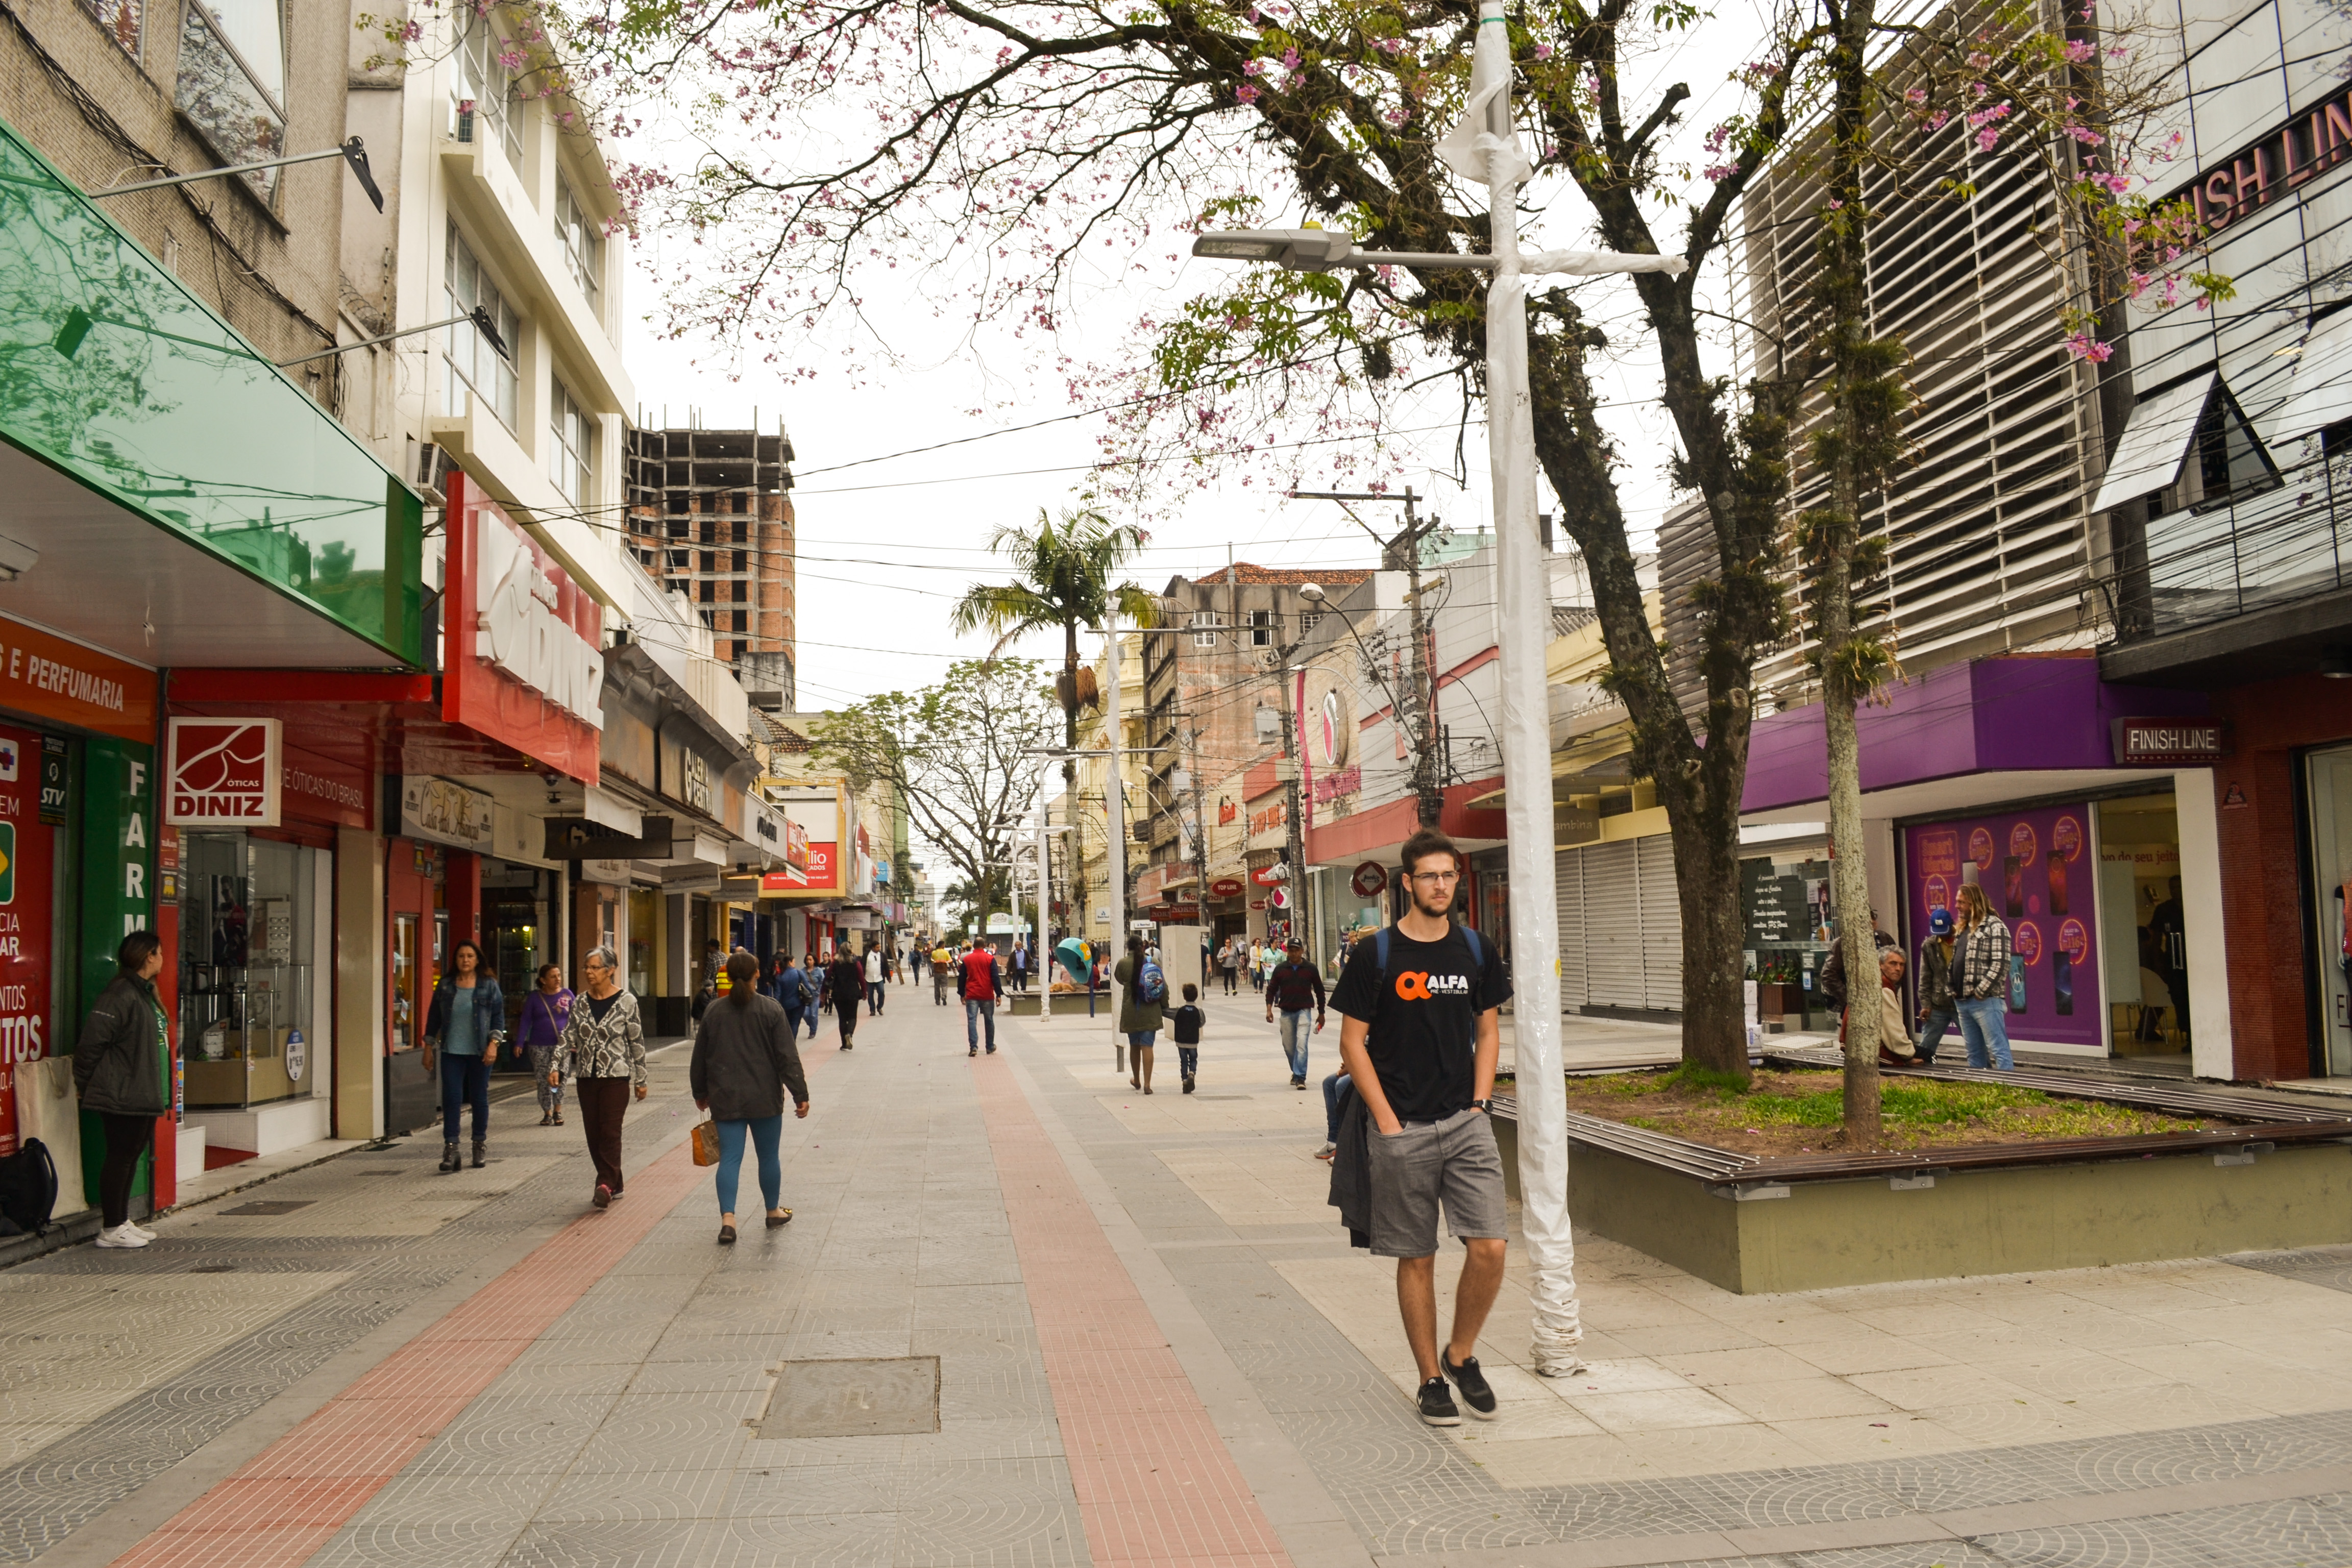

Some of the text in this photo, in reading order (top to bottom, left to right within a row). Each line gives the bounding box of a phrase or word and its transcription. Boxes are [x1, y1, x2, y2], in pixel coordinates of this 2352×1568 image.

[516, 595, 604, 730] DINIZ
[9, 647, 123, 712] E PERFUMARIA
[2130, 729, 2215, 750] FINISH LINE
[40, 788, 65, 805] STV
[293, 767, 324, 797] ÓTICAS
[326, 780, 337, 801] DO
[339, 785, 364, 809] BRASIL
[174, 796, 263, 816] DINIZ
[2135, 853, 2153, 862] seu
[2156, 849, 2179, 865] jeito
[1427, 975, 1468, 989] ALFA
